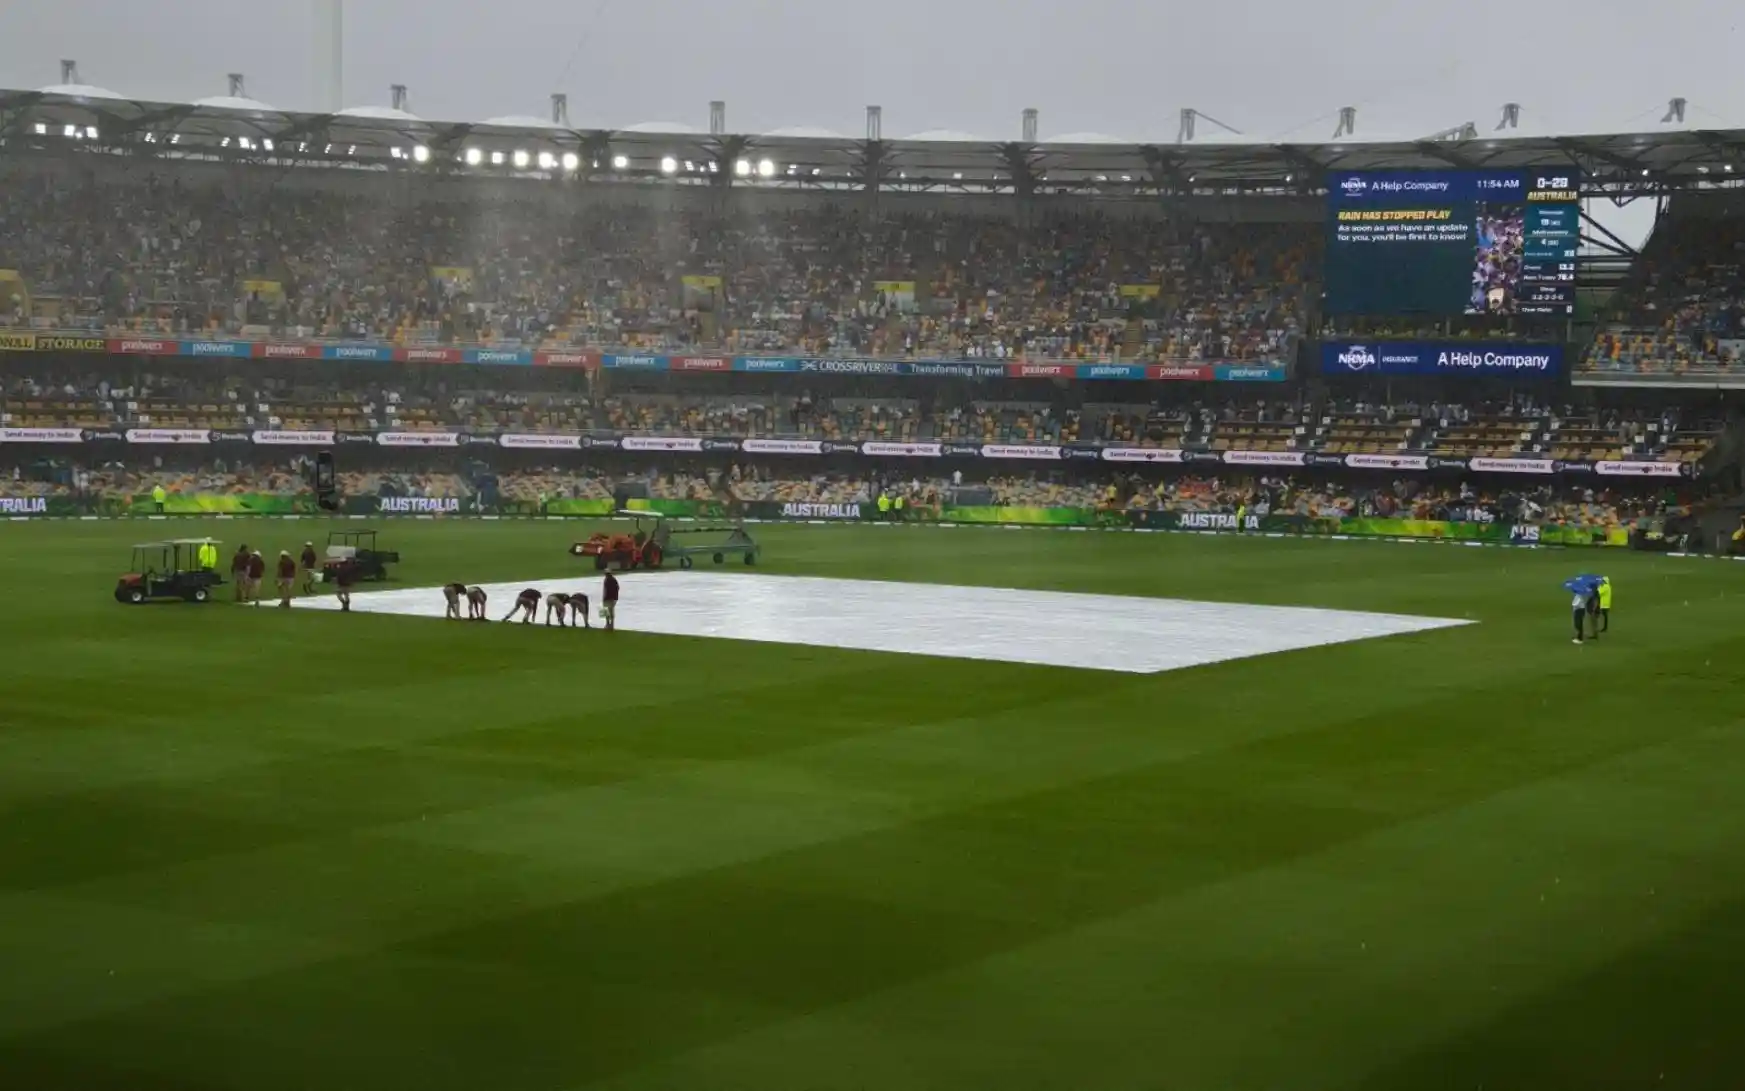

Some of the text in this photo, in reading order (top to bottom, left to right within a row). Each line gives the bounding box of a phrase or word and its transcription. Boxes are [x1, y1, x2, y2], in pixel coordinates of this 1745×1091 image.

[1372, 181, 1449, 192] A Help Company
[1477, 180, 1519, 188] 11:54 AM
[1527, 191, 1577, 200] AUSTRALIA
[1338, 210, 1451, 220] RAIN HAS STOPPED PLAY
[1436, 224, 1468, 233] update
[1372, 233, 1394, 242] you'll
[38, 338, 105, 350] STORAGE
[1338, 353, 1375, 364] NRMA
[1437, 352, 1549, 369] A Help Company
[911, 364, 1004, 377] Transforming Travel
[0, 497, 47, 512] RALIA
[380, 497, 459, 511] AUSTRALIA
[782, 503, 860, 517] AUSTRALIA
[1180, 512, 1259, 528] AUSTRAIA
